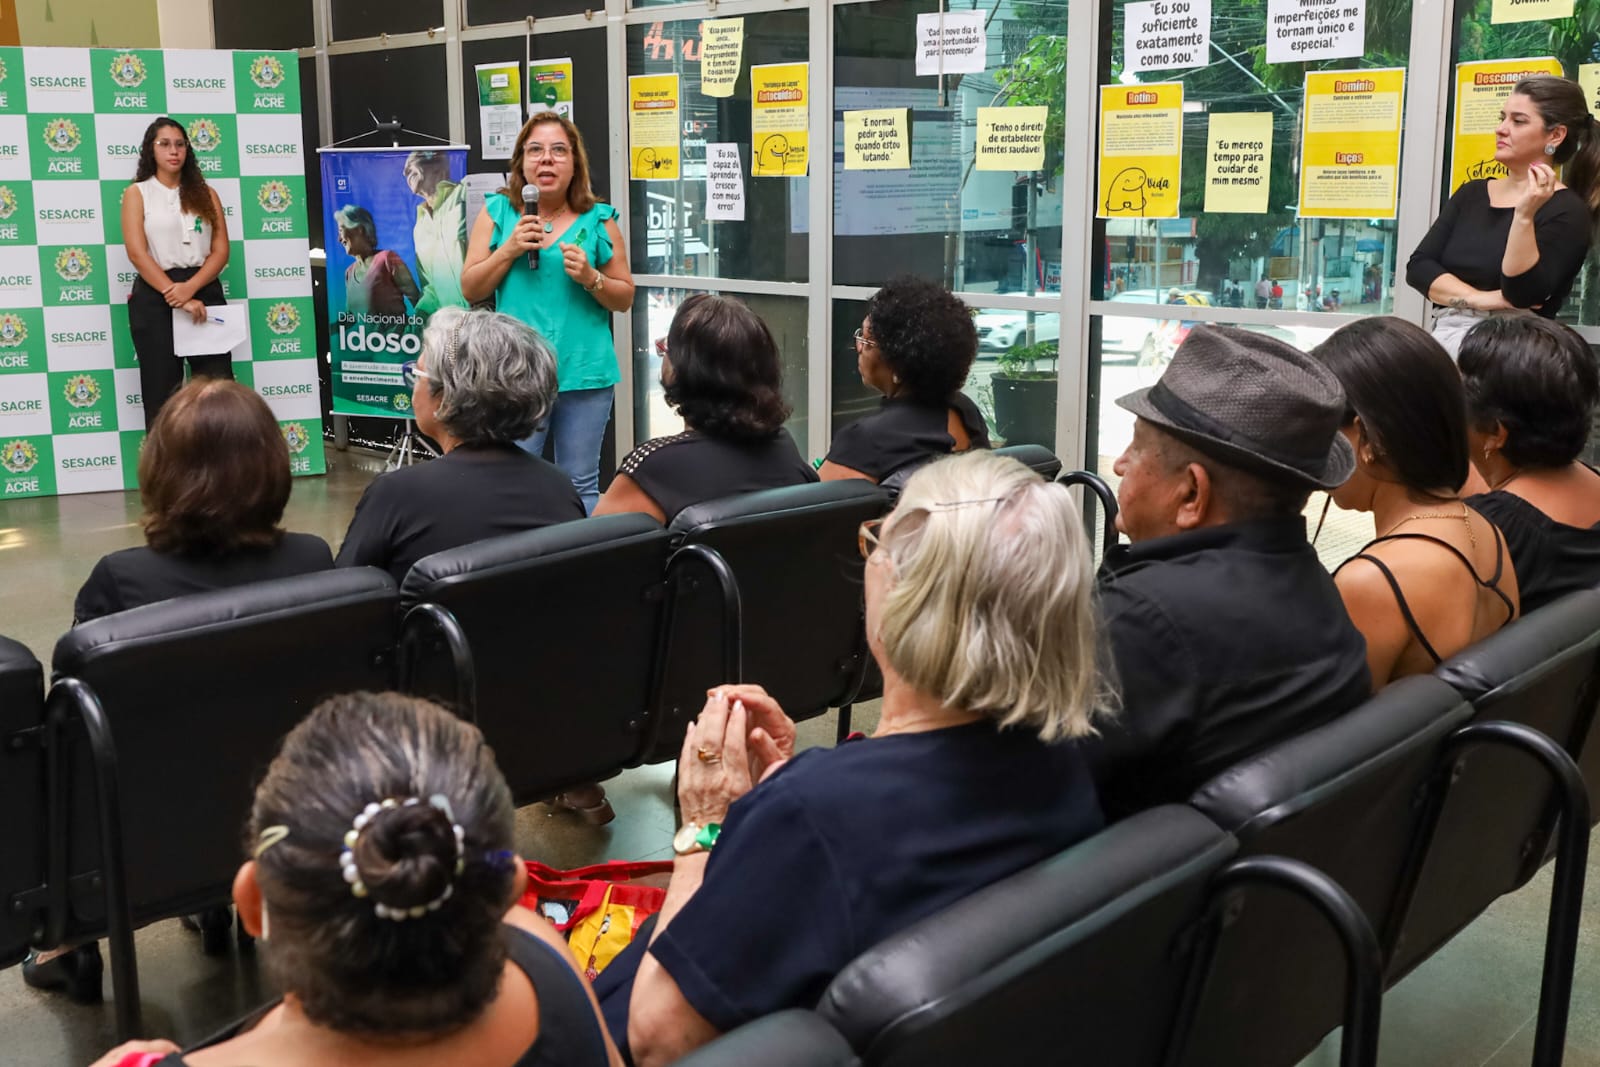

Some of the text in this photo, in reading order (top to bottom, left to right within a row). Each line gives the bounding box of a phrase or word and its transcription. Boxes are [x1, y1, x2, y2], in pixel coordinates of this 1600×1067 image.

[1150, 2, 1190, 15] "Eu sou
[1274, 7, 1358, 26] imperfeições me
[1142, 17, 1198, 33] suficiente
[1277, 25, 1314, 38] tornam
[1348, 22, 1354, 32] e
[945, 28, 960, 36] novo
[962, 26, 972, 35] dia
[1136, 34, 1202, 50] exatamente
[1291, 36, 1339, 53] especial."
[926, 48, 940, 58] para
[1141, 50, 1198, 66] como sou."
[30, 77, 86, 88] SESACRE
[173, 79, 226, 88] SESACRE
[758, 89, 802, 102] Autocuidado
[1127, 91, 1158, 105] Rotina
[114, 97, 148, 108] ACRE
[254, 97, 285, 108] ACRE
[870, 117, 895, 126] normal
[858, 129, 898, 142] pedir ajuda
[988, 133, 1042, 143] de estabelecer
[246, 144, 296, 154] SESACRE
[855, 140, 900, 153] quando estou
[982, 145, 1007, 154] limites
[1216, 140, 1263, 152] "Eu mereço
[1214, 152, 1264, 163] tempo para
[1336, 152, 1363, 165] Laços
[48, 162, 82, 172] ACRE
[199, 161, 222, 171] CRE
[713, 162, 731, 171] capaz
[1218, 164, 1258, 174] cuidar de
[710, 172, 737, 181] aprender
[1212, 176, 1264, 185] mim mesmo"
[40, 209, 96, 219] SESACRE
[261, 222, 293, 232] ACRE
[254, 267, 306, 278] SESACRE
[0, 276, 32, 286] ACRE
[60, 290, 94, 301] ACRE
[338, 312, 424, 325] Dia Nacional do
[52, 332, 107, 342] SESACRE
[340, 326, 420, 354] Idoso
[270, 343, 301, 354] ACRE
[262, 384, 312, 396] SESACRE
[356, 394, 389, 403] SESACRE
[0, 400, 42, 411] SACRE
[68, 416, 102, 428] ACRE
[62, 456, 117, 468] SESACRE
[5, 482, 40, 493] ACRE
